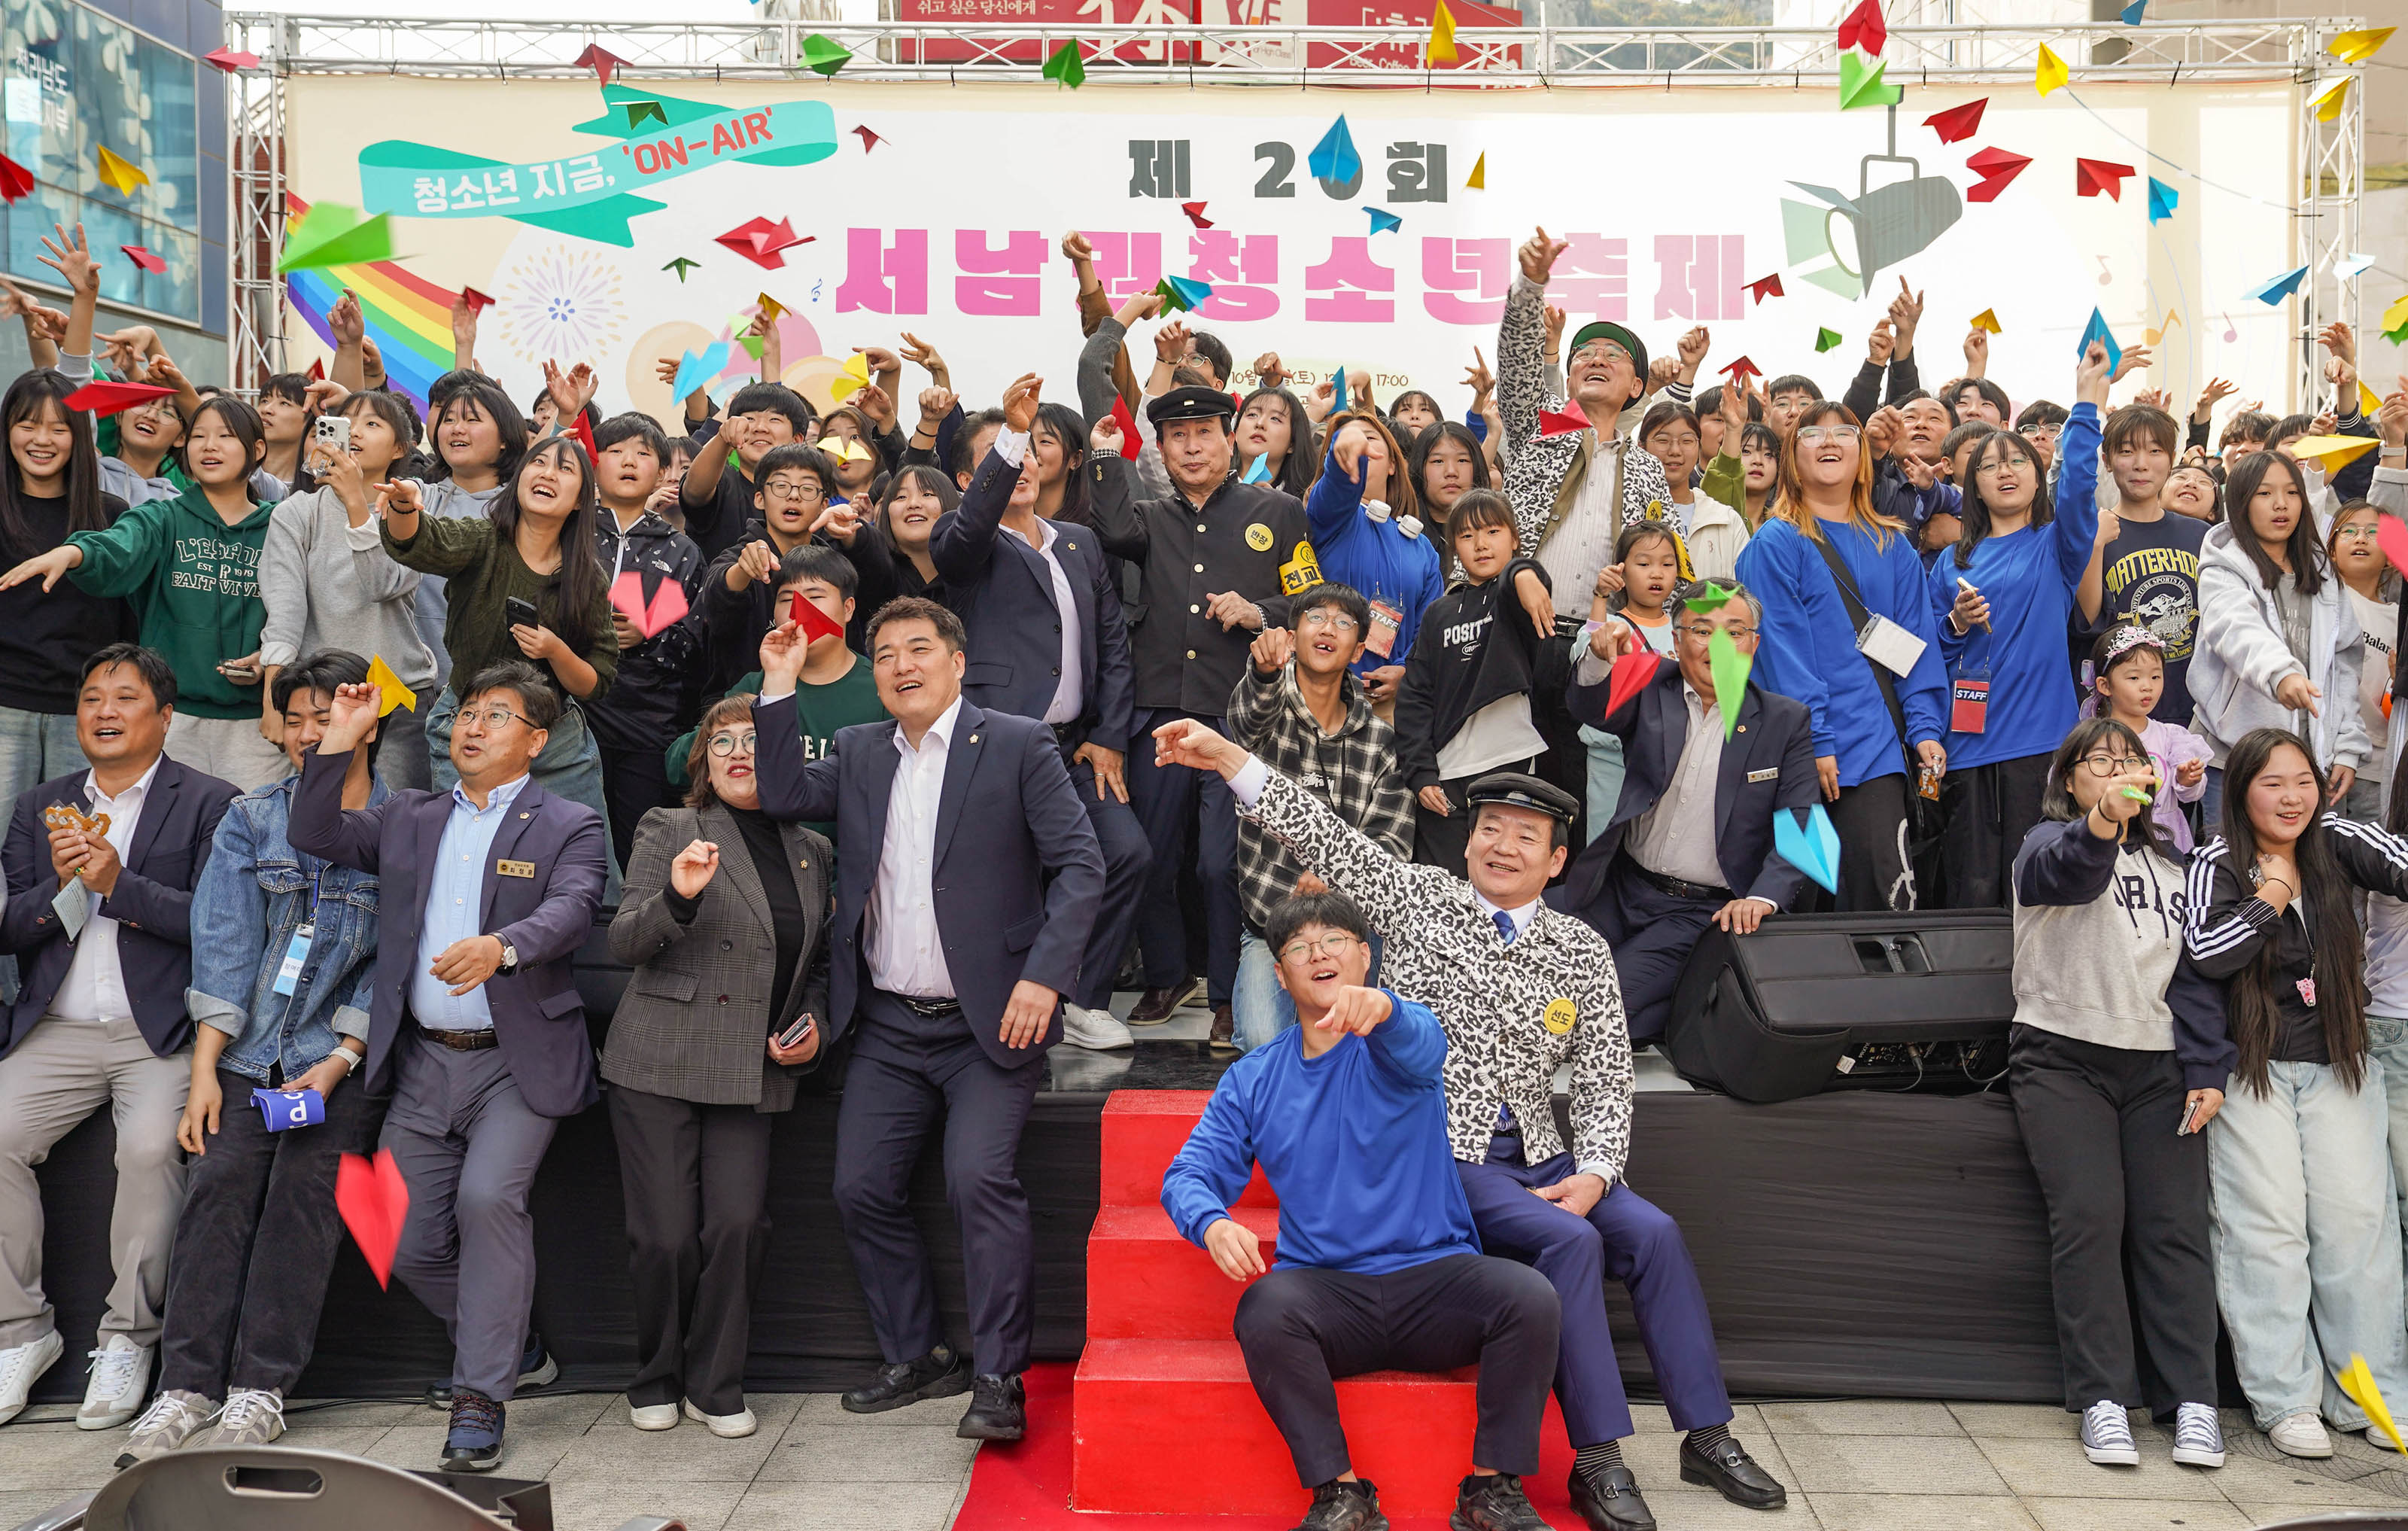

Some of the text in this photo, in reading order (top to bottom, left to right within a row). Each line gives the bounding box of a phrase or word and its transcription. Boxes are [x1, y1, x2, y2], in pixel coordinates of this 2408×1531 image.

[917, 0, 947, 14] 쉬고
[949, 0, 978, 15] 싶은
[981, 0, 1036, 16] 당신에게
[413, 106, 774, 215] 청소년 지금, 'ON-AIR'
[1129, 139, 1190, 199] 제
[1376, 373, 1409, 387] 17:00
[1250, 529, 1269, 546] 반장
[172, 571, 217, 592] FAIT
[1284, 565, 1323, 591] 전교
[2152, 577, 2178, 586] SPORTS
[1369, 610, 1400, 629] STAFF
[1443, 611, 1494, 648] POSIT
[1956, 689, 1987, 701] STAFF
[1550, 1009, 1571, 1026] 선도
